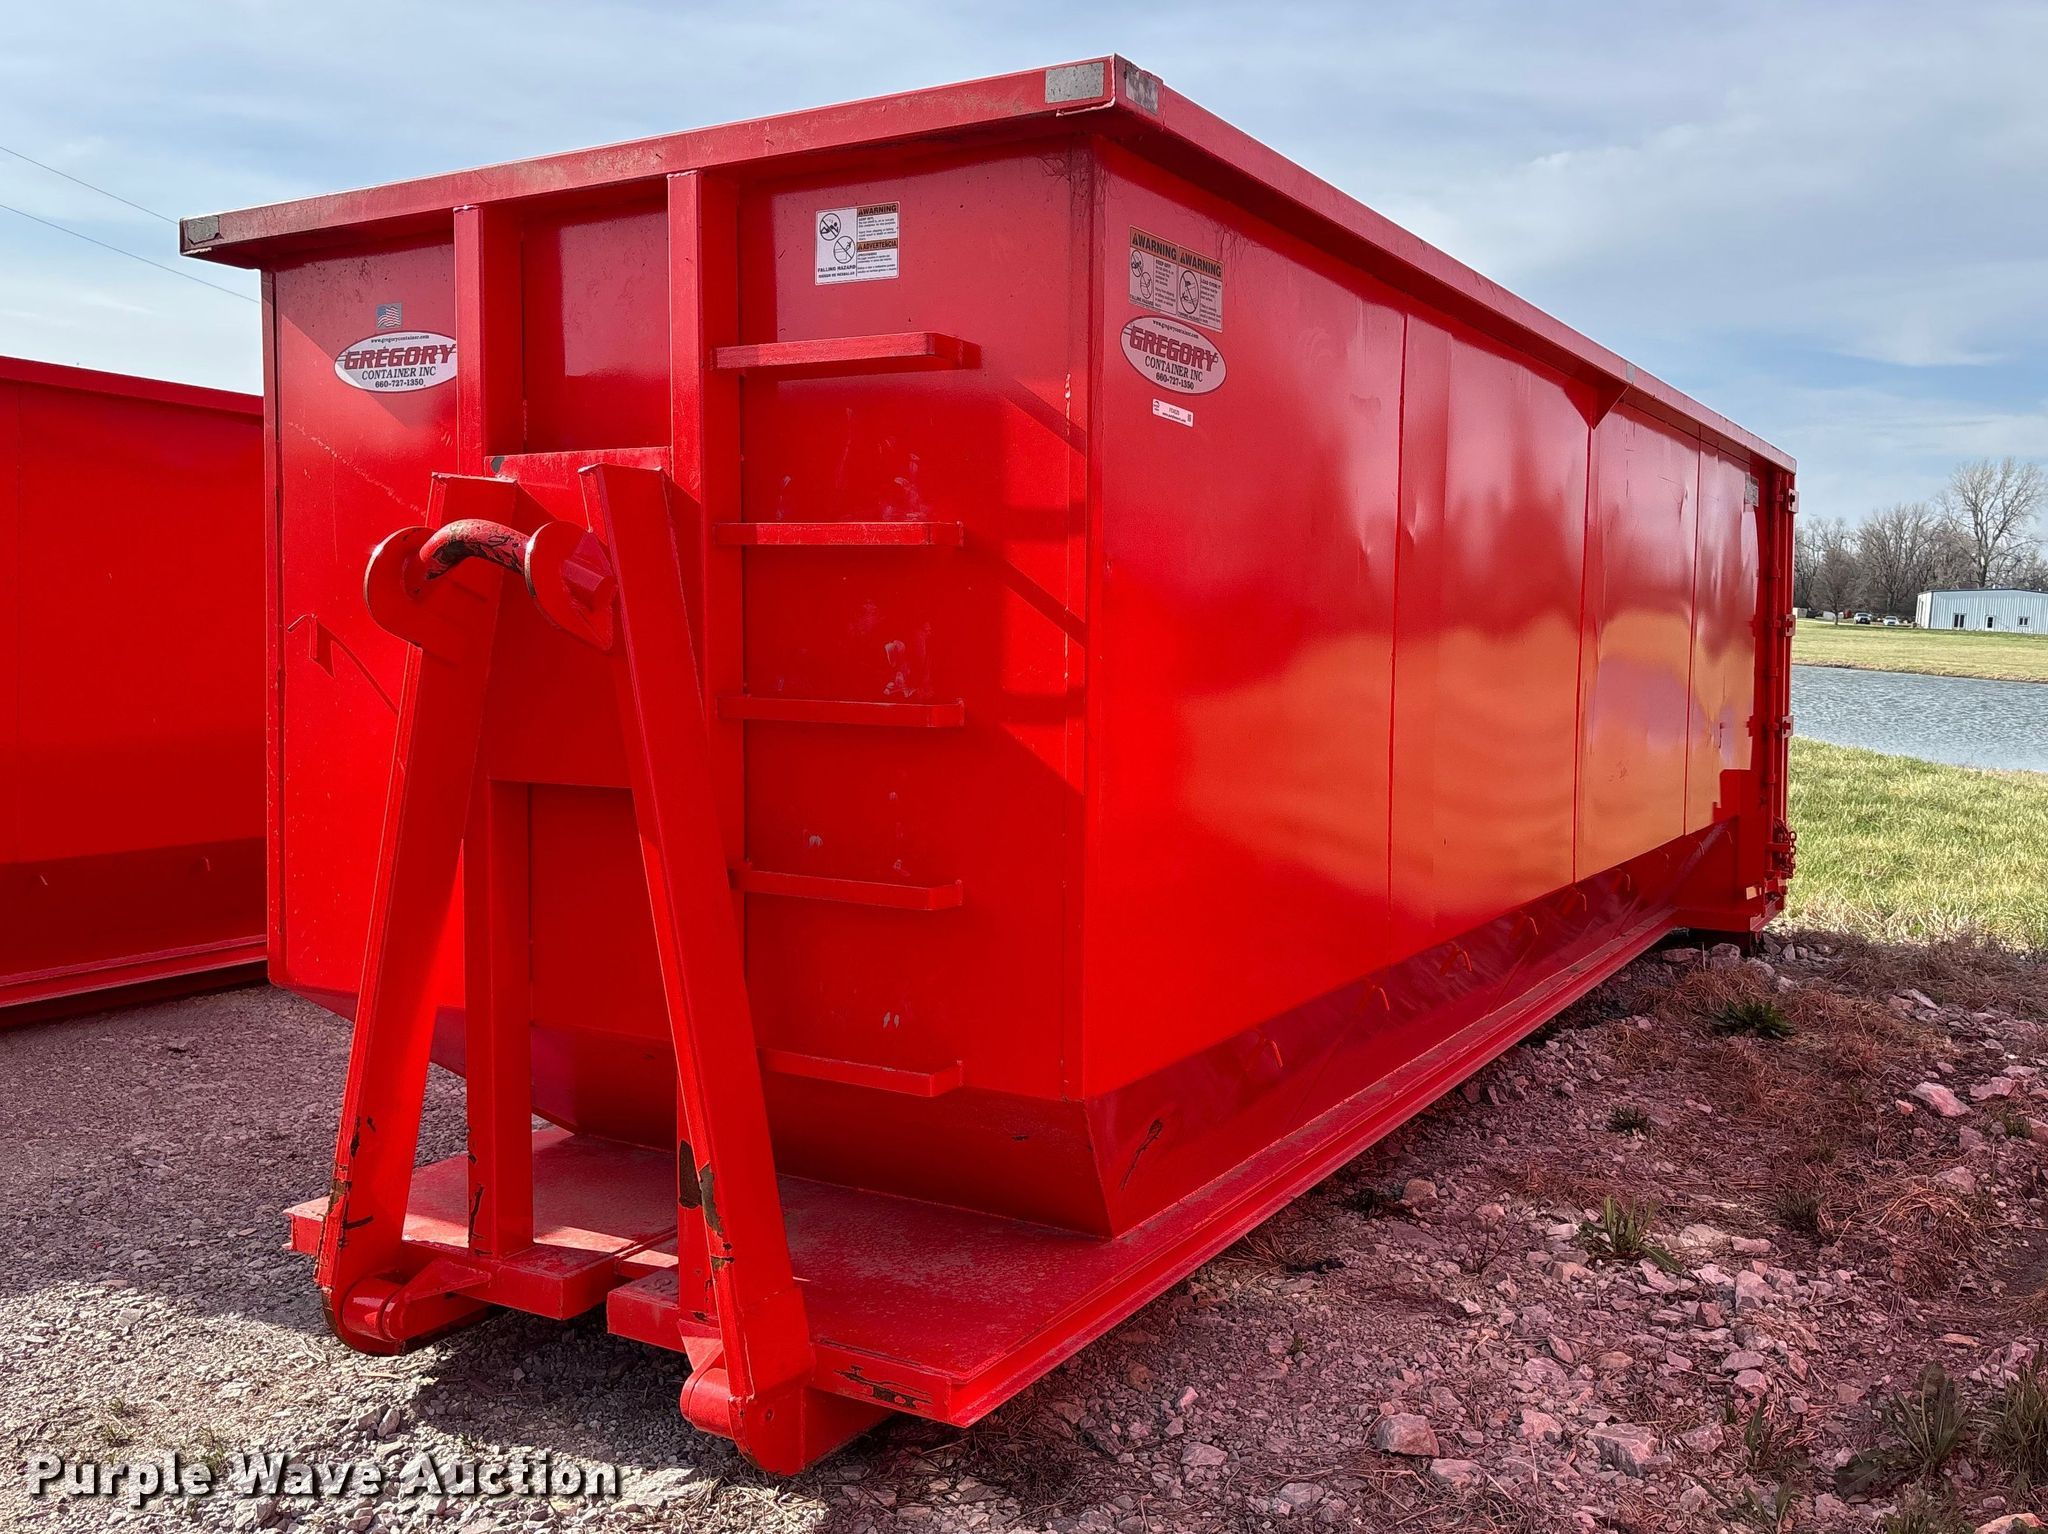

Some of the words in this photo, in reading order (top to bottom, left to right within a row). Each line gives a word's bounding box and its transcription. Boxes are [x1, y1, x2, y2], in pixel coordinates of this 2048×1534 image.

[863, 205, 897, 215] WARNING
[863, 240, 897, 250] ADVERTENCIA
[1138, 235, 1177, 260] WARNING
[1185, 253, 1222, 278] WARNING
[1152, 320, 1199, 339] www.gregorycontainer.com
[371, 334, 430, 344] www.gregorycontainer.com
[343, 344, 456, 370] GREGORY
[1130, 325, 1218, 372] GREGORY
[361, 367, 416, 380] CONTAINER
[419, 366, 437, 377] INC
[1145, 355, 1189, 379] CONTAINER
[1190, 370, 1203, 383] INC
[375, 378, 424, 388] 660-727-1350
[1155, 372, 1195, 390] 660-727-1350
